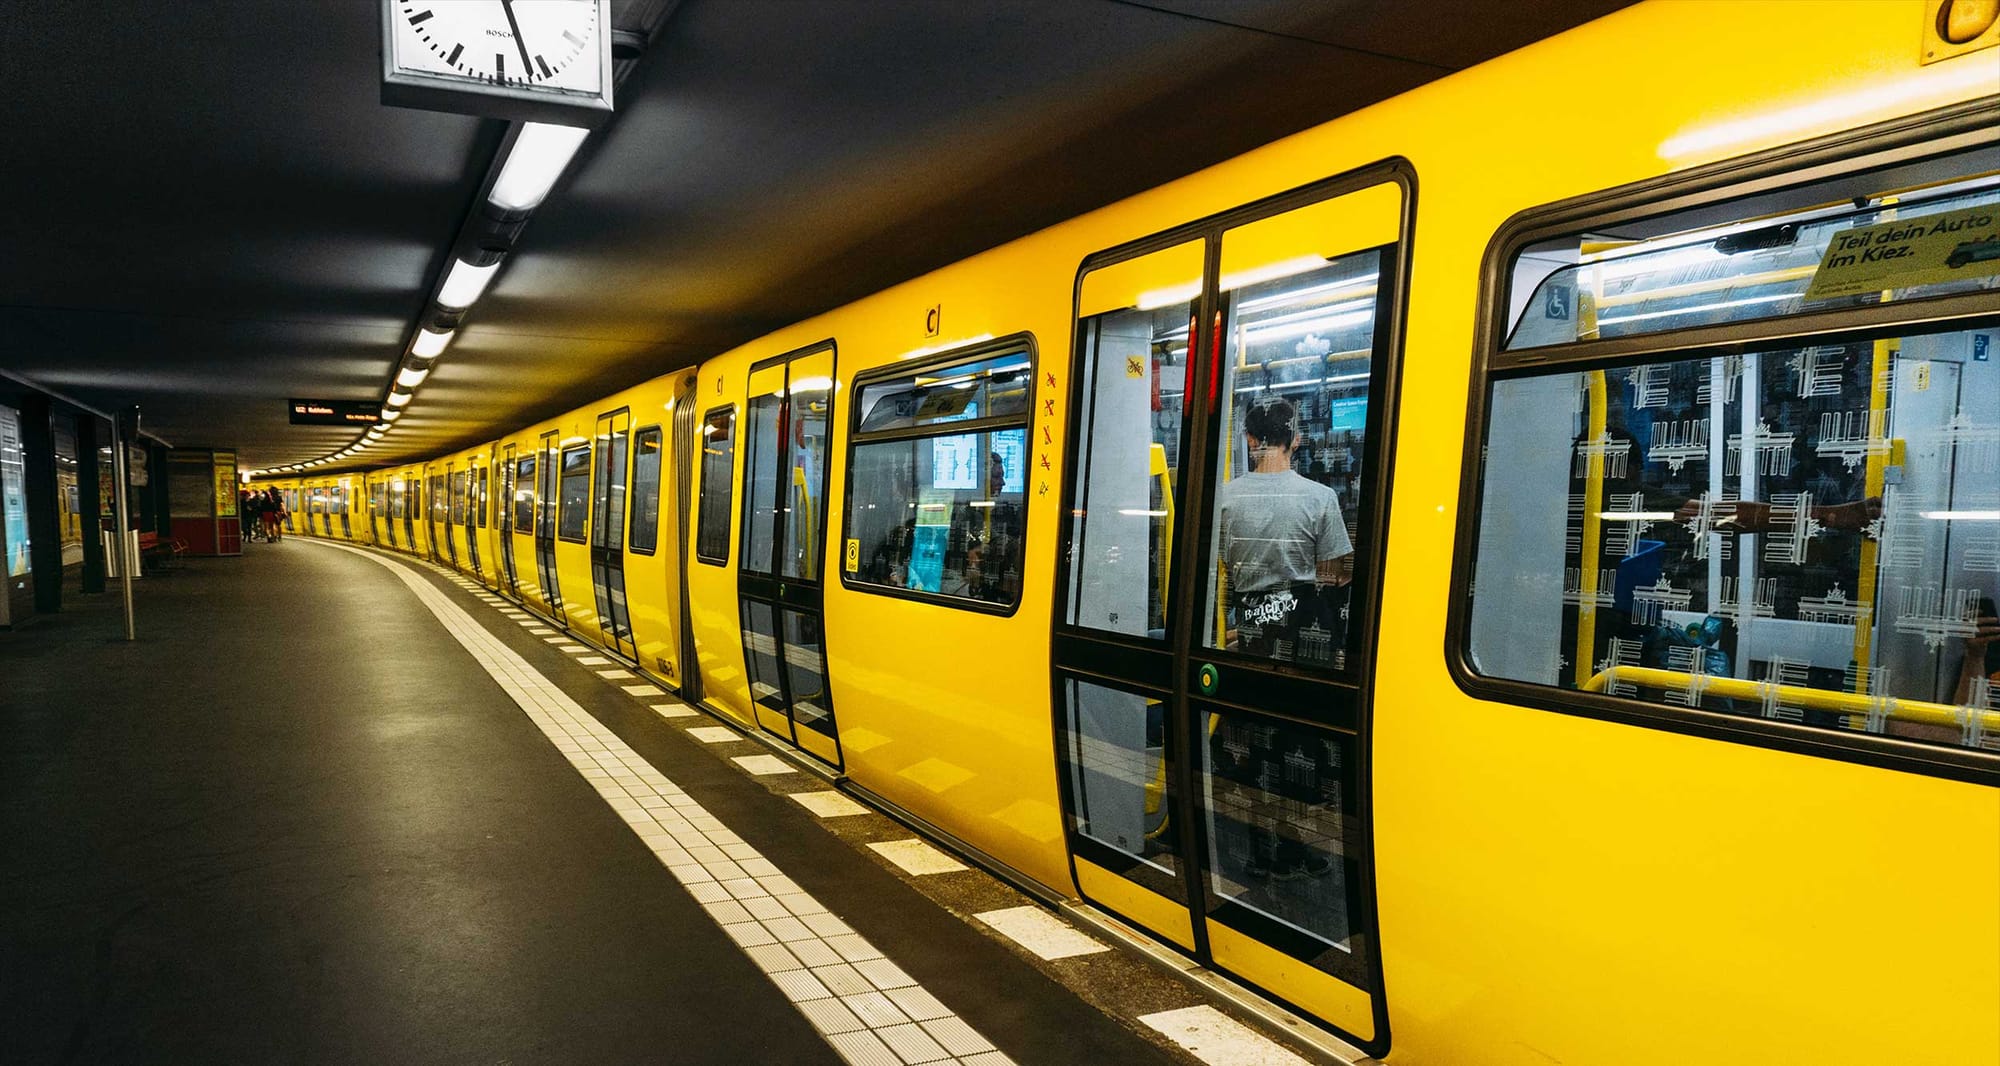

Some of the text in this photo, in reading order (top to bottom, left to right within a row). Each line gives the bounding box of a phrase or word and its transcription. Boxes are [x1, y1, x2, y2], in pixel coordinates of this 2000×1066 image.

[1838, 214, 1992, 251] Teil dein Auto
[1827, 245, 1915, 269] im Kiez.
